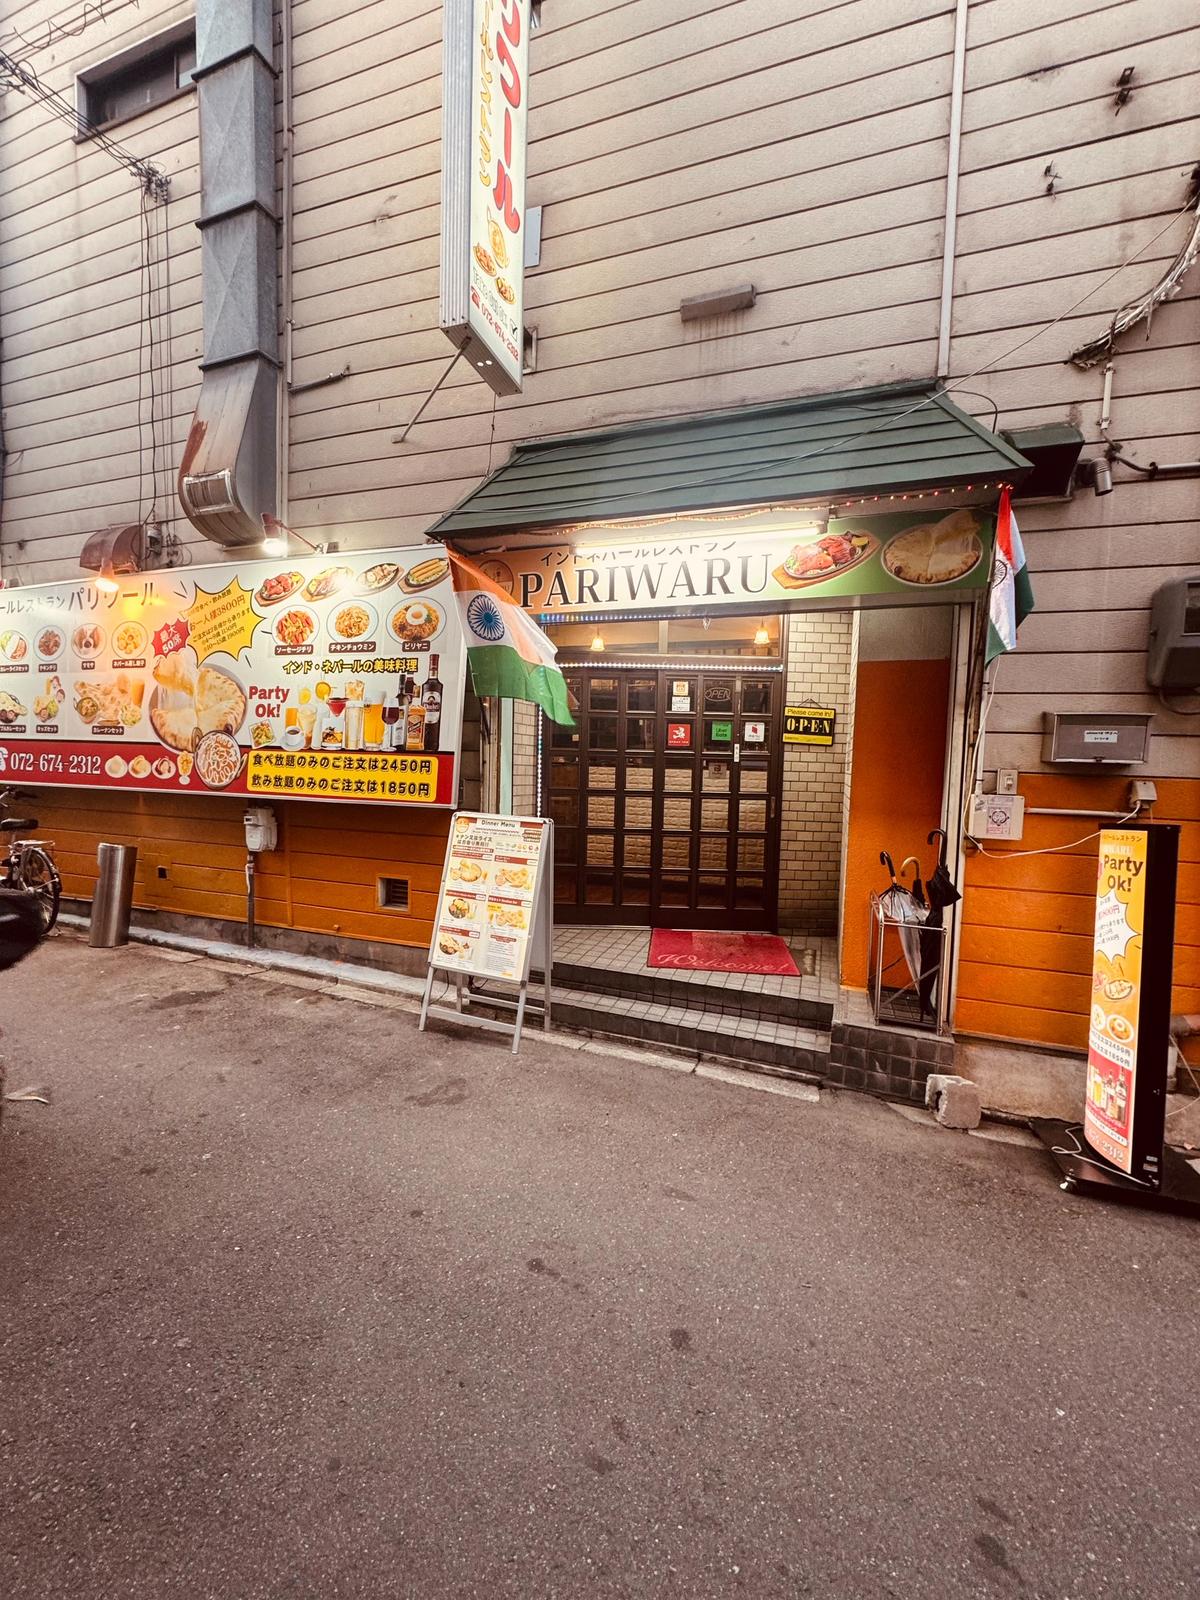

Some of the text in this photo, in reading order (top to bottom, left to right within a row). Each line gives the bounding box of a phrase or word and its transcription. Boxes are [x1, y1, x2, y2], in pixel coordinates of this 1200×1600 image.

[519, 553, 773, 608] PARIWARU
[330, 642, 375, 652] チキンチョウミン
[283, 658, 418, 674] インド・ネパールの美味料理
[249, 686, 290, 703] Party
[704, 688, 730, 700] OPEN
[255, 703, 281, 719] Ok!
[787, 708, 807, 716] Please
[10, 752, 101, 775] 072-674-2312
[252, 754, 432, 774] 食べ放題のみのご注文は2450円
[251, 774, 430, 797] 飲み放題のみのご注文は1850円
[481, 819, 500, 827] Dinner
[1104, 854, 1144, 876] Party
[1107, 875, 1132, 892] Ok!
